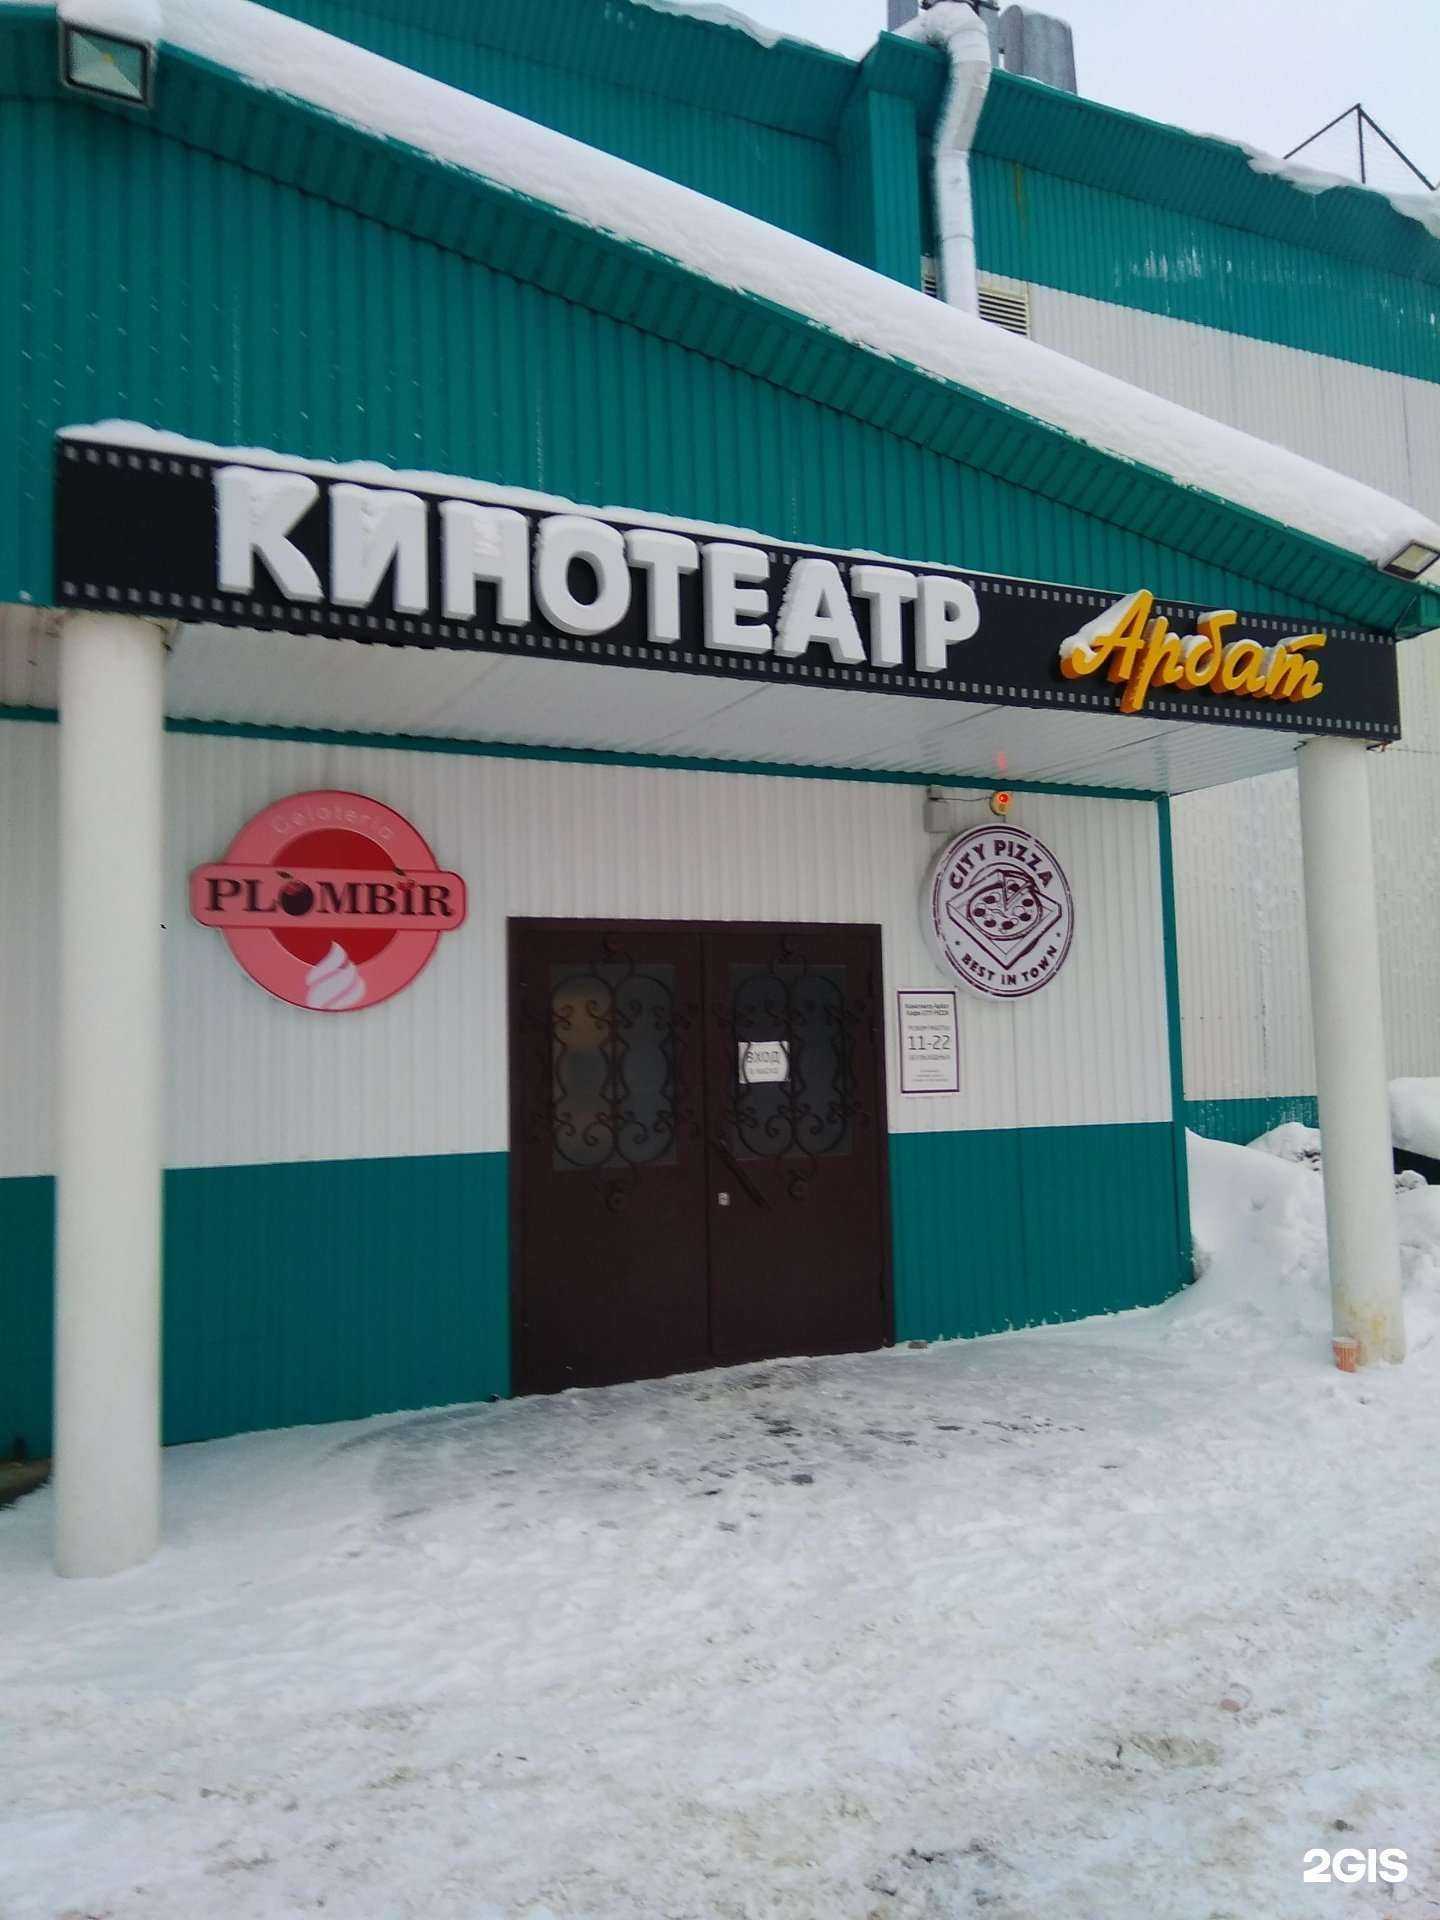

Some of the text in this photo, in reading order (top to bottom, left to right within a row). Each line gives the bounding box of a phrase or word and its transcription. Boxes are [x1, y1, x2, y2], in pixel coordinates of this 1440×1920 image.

[211, 465, 1327, 713] КИНОТЕАТР Арбат
[949, 839, 1053, 890] CITY PIZZA
[961, 945, 1058, 986] BEST IN TOWN
[908, 1035, 950, 1051] 11-22
